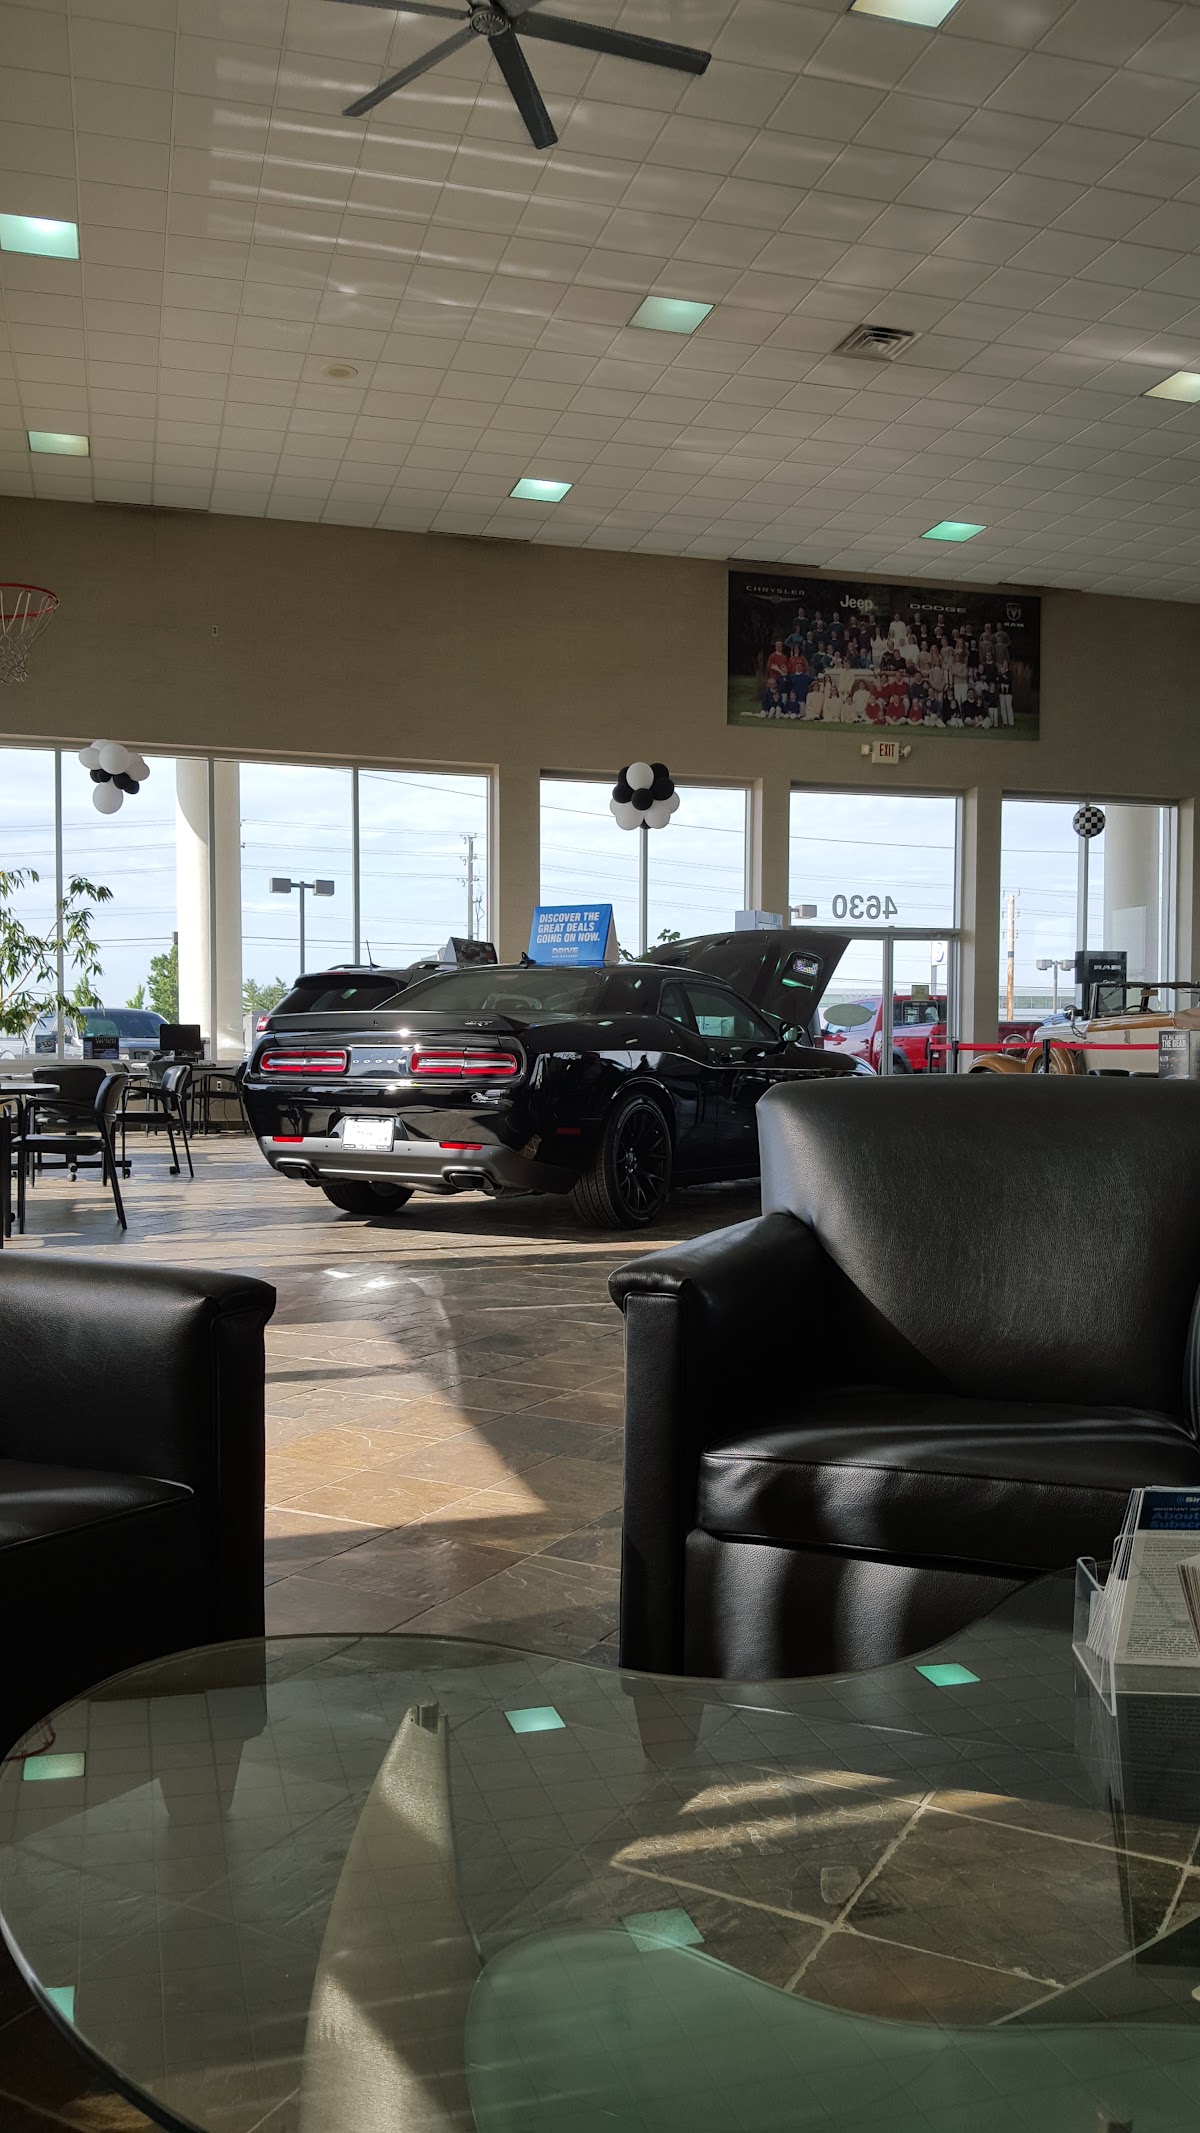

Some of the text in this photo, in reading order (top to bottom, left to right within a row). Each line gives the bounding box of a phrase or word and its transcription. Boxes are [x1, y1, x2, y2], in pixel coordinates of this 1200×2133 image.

[745, 585, 806, 596] CHRYSLER
[839, 594, 873, 611] Jeep
[909, 603, 967, 614] DODGE
[879, 743, 896, 758] EXIT
[539, 911, 600, 923] DISCOVER THE
[538, 922, 595, 934] GREAT DEALS
[536, 932, 600, 944] GOING ON NOW.
[552, 946, 579, 955] DRIVE
[1162, 1040, 1187, 1048] THE GEAR
[1151, 1511, 1200, 1520] About
